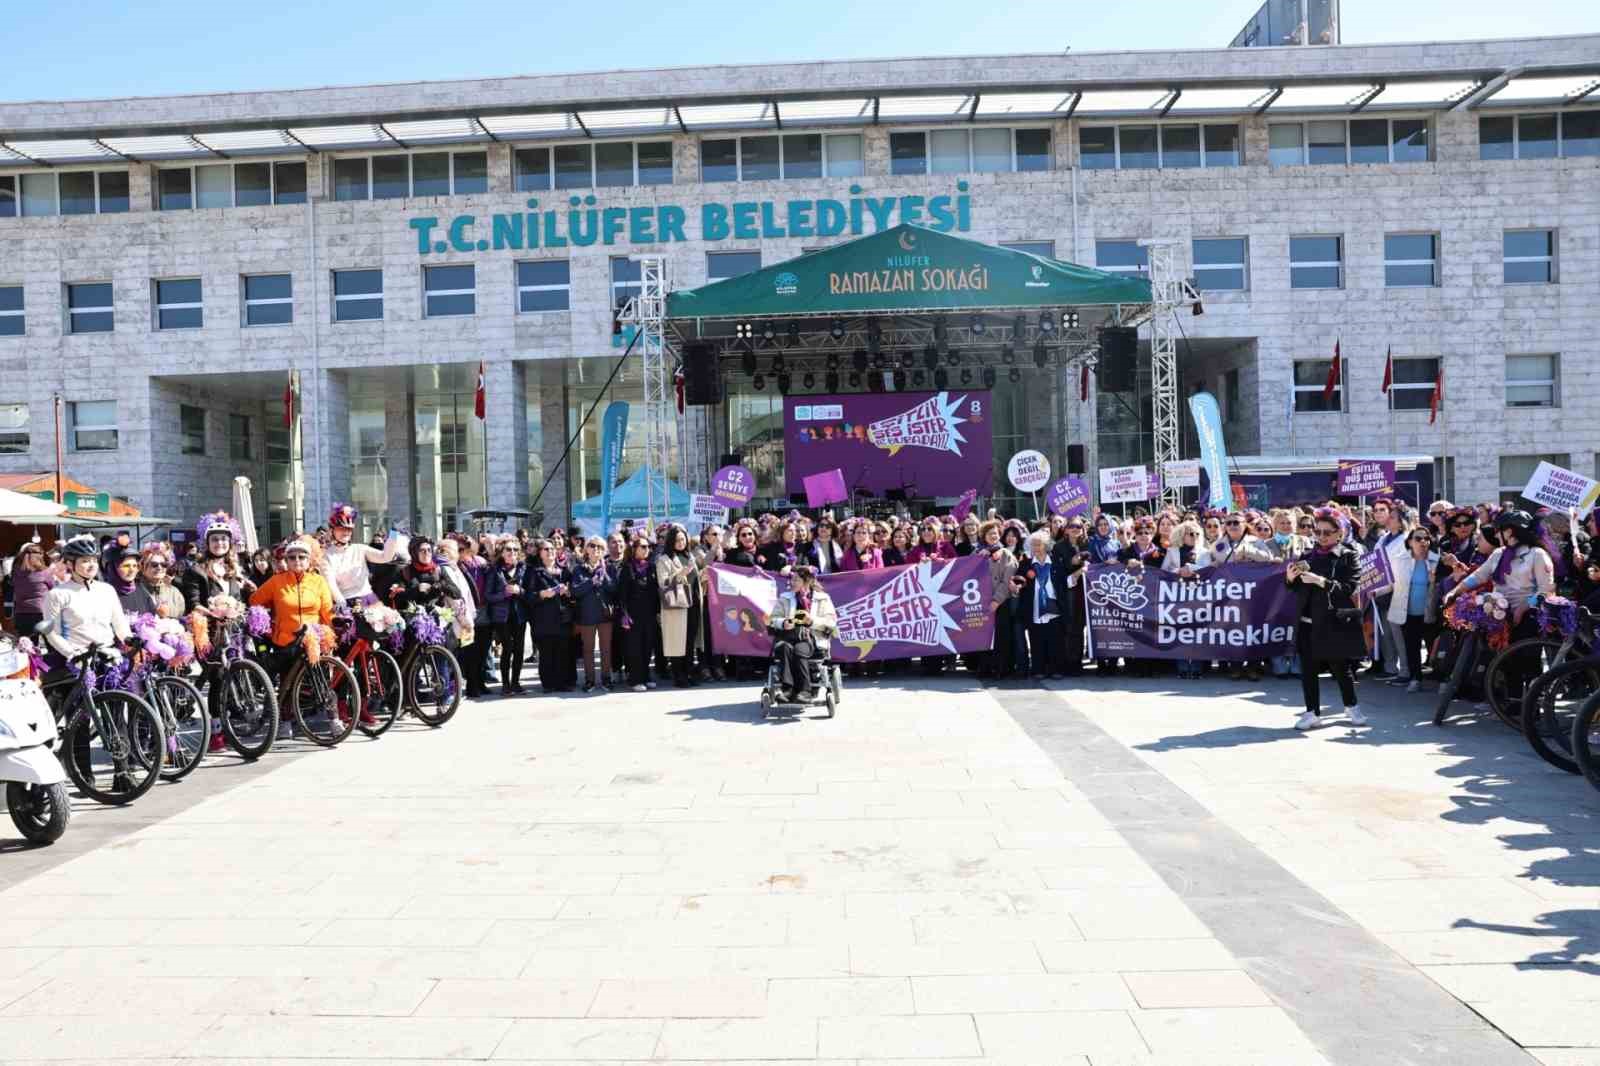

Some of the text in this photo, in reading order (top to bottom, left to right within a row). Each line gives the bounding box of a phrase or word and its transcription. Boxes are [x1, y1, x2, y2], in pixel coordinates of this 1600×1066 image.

[702, 180, 971, 240] BELEDİYESİ
[830, 263, 989, 295] RAMAZAN SOKAĞI
[971, 400, 981, 412] 8
[728, 470, 744, 483] C2
[1056, 480, 1072, 494] C2
[963, 579, 981, 604] 8
[1158, 578, 1256, 602] Nilüfer
[837, 612, 875, 632] SES
[881, 596, 937, 626] İSTER
[1092, 607, 1144, 621] NİLÜFER
[1092, 619, 1143, 629] BELEDİYESİ
[1158, 603, 1240, 625] Kadın
[856, 619, 939, 644] BURADAYIZ
